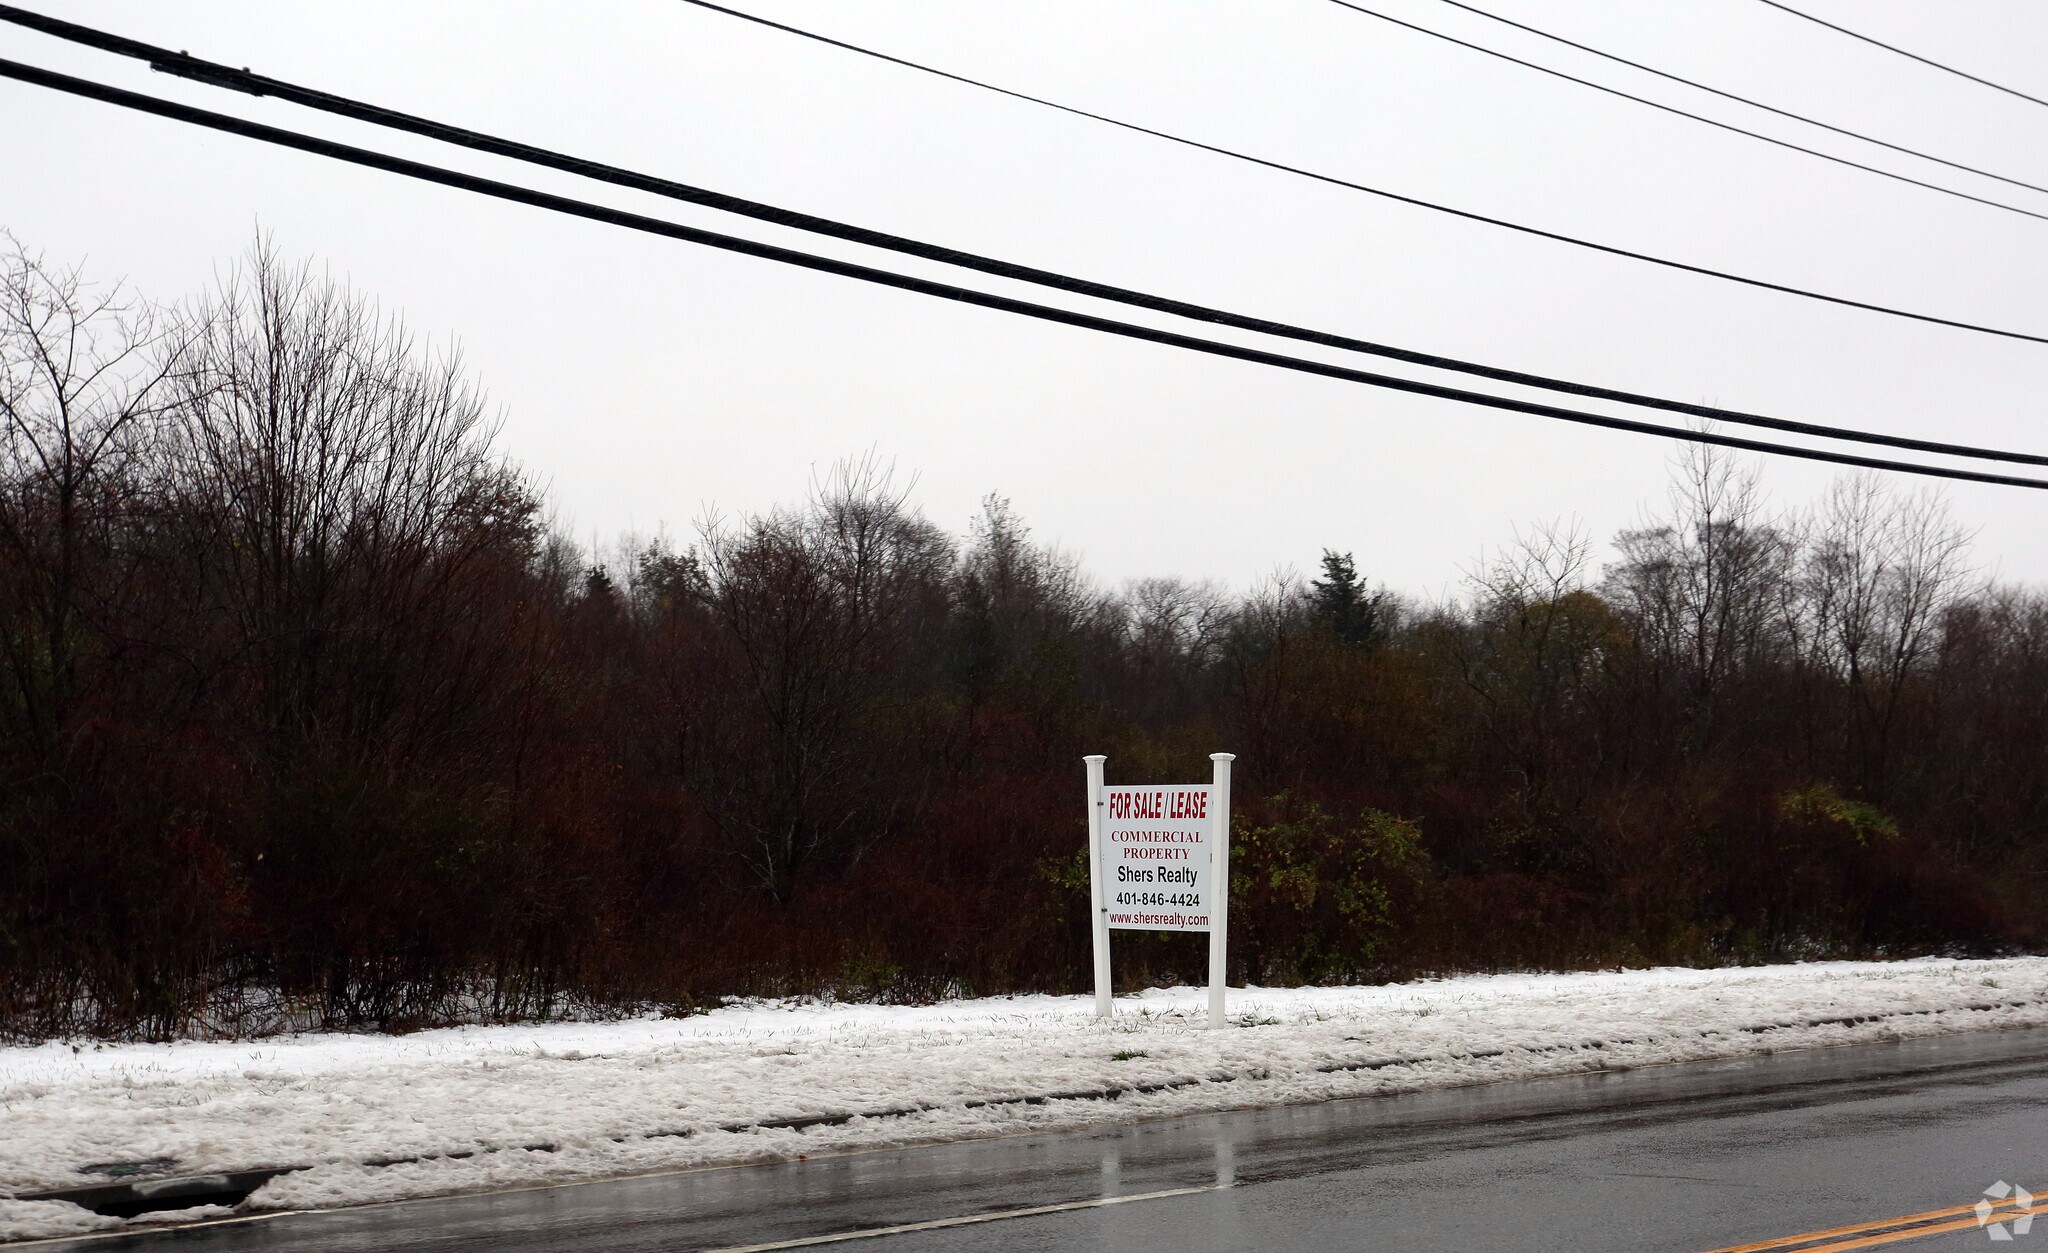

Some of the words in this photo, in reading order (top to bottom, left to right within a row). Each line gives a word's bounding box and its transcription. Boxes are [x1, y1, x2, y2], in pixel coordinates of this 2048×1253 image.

[1109, 792, 1131, 819] FOR
[1111, 830, 1203, 843] COMMERCIAL
[1123, 847, 1190, 860] PROPERTY
[1117, 865, 1153, 883] Shers
[1157, 866, 1197, 887] Realty
[1116, 891, 1200, 907] 401-846-4424
[1109, 911, 1209, 928] www.shersrealty.com
